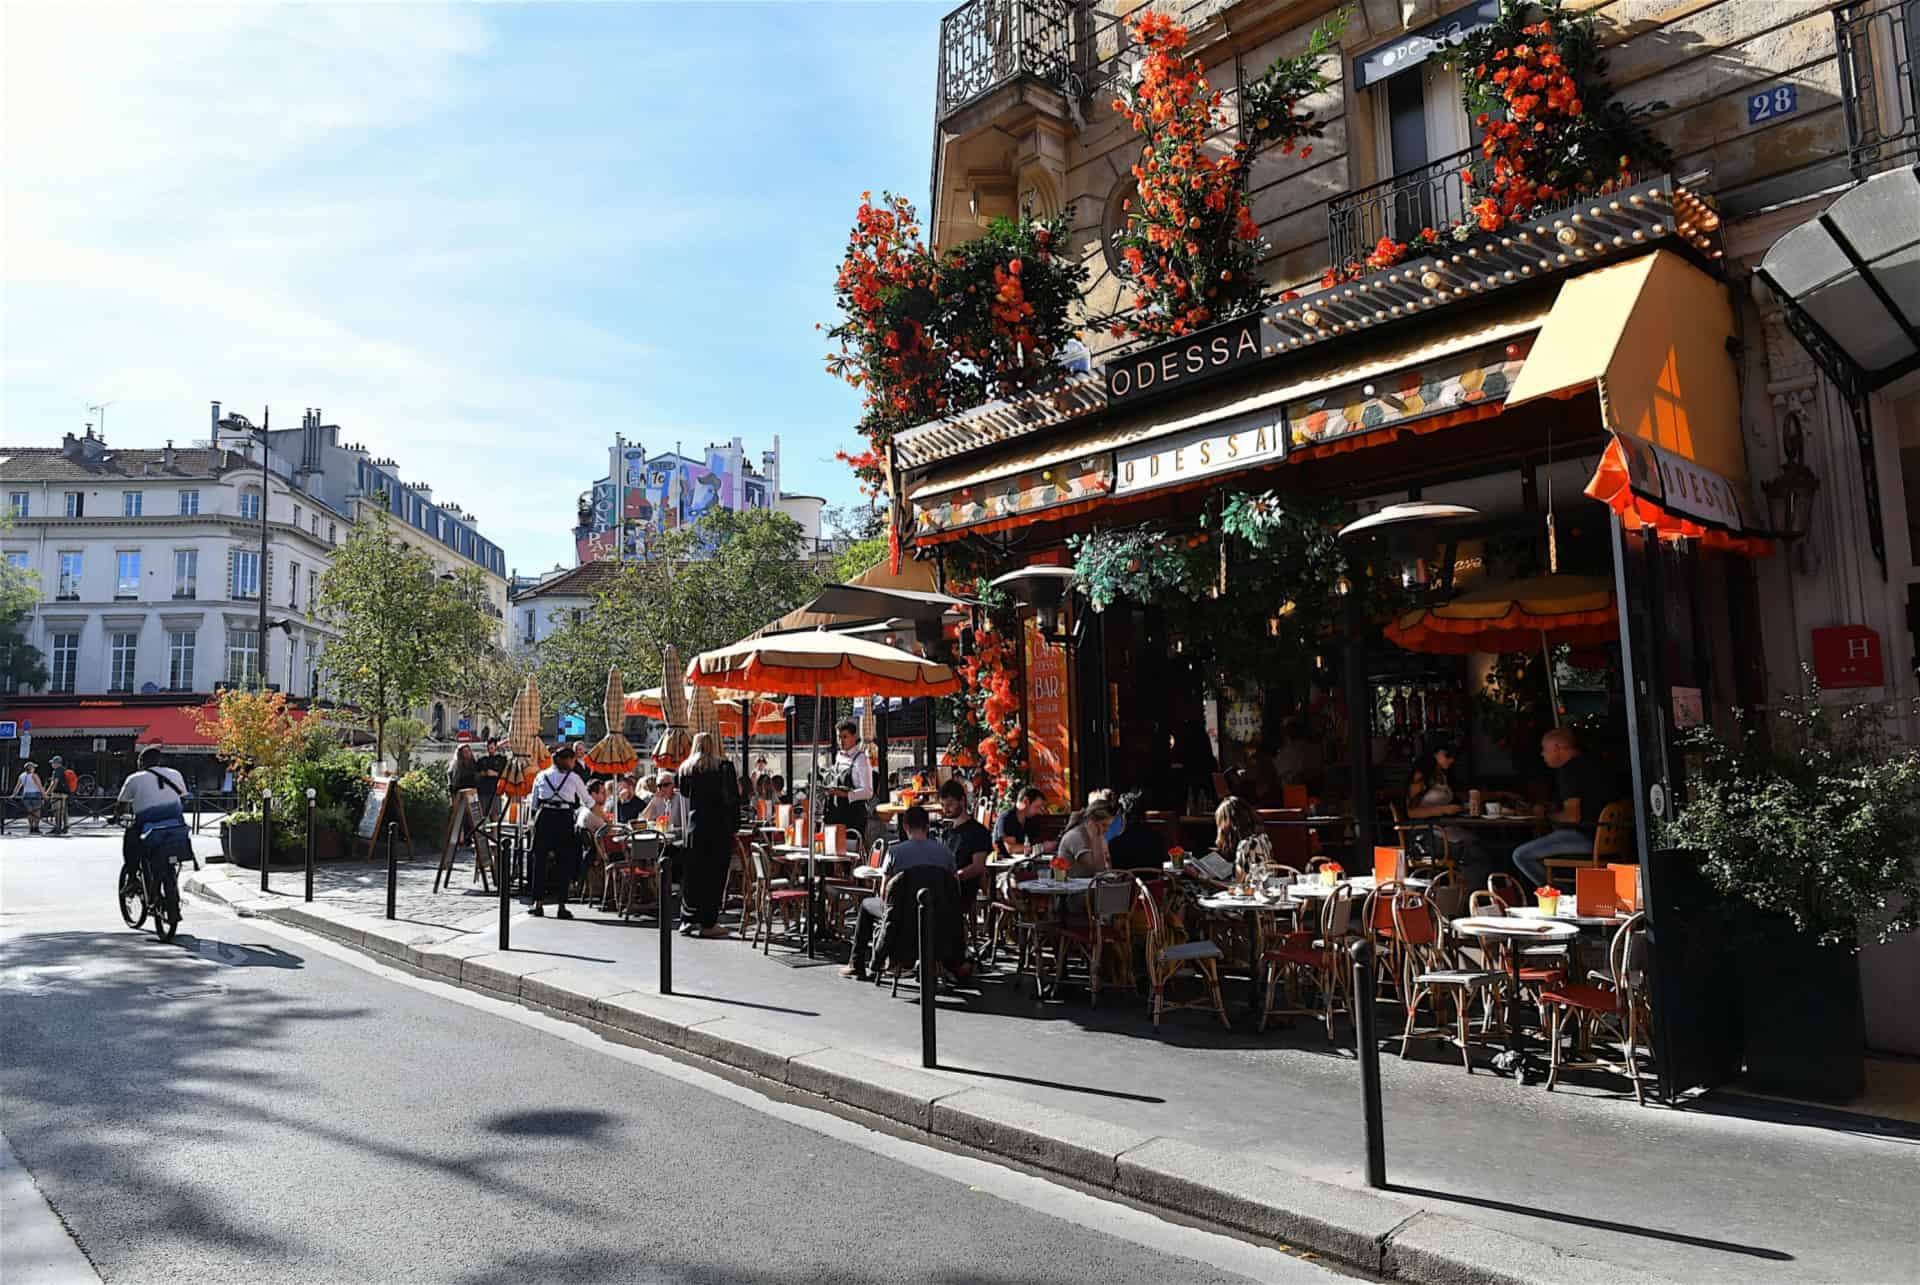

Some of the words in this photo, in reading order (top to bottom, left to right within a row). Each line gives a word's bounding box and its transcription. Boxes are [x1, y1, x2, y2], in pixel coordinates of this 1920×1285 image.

[1753, 86, 1792, 122] 28
[1111, 328, 1257, 396] ODESSA
[1124, 427, 1267, 483] ODESSA
[1848, 638, 1871, 659] H
[1034, 676, 1059, 699] BAR
